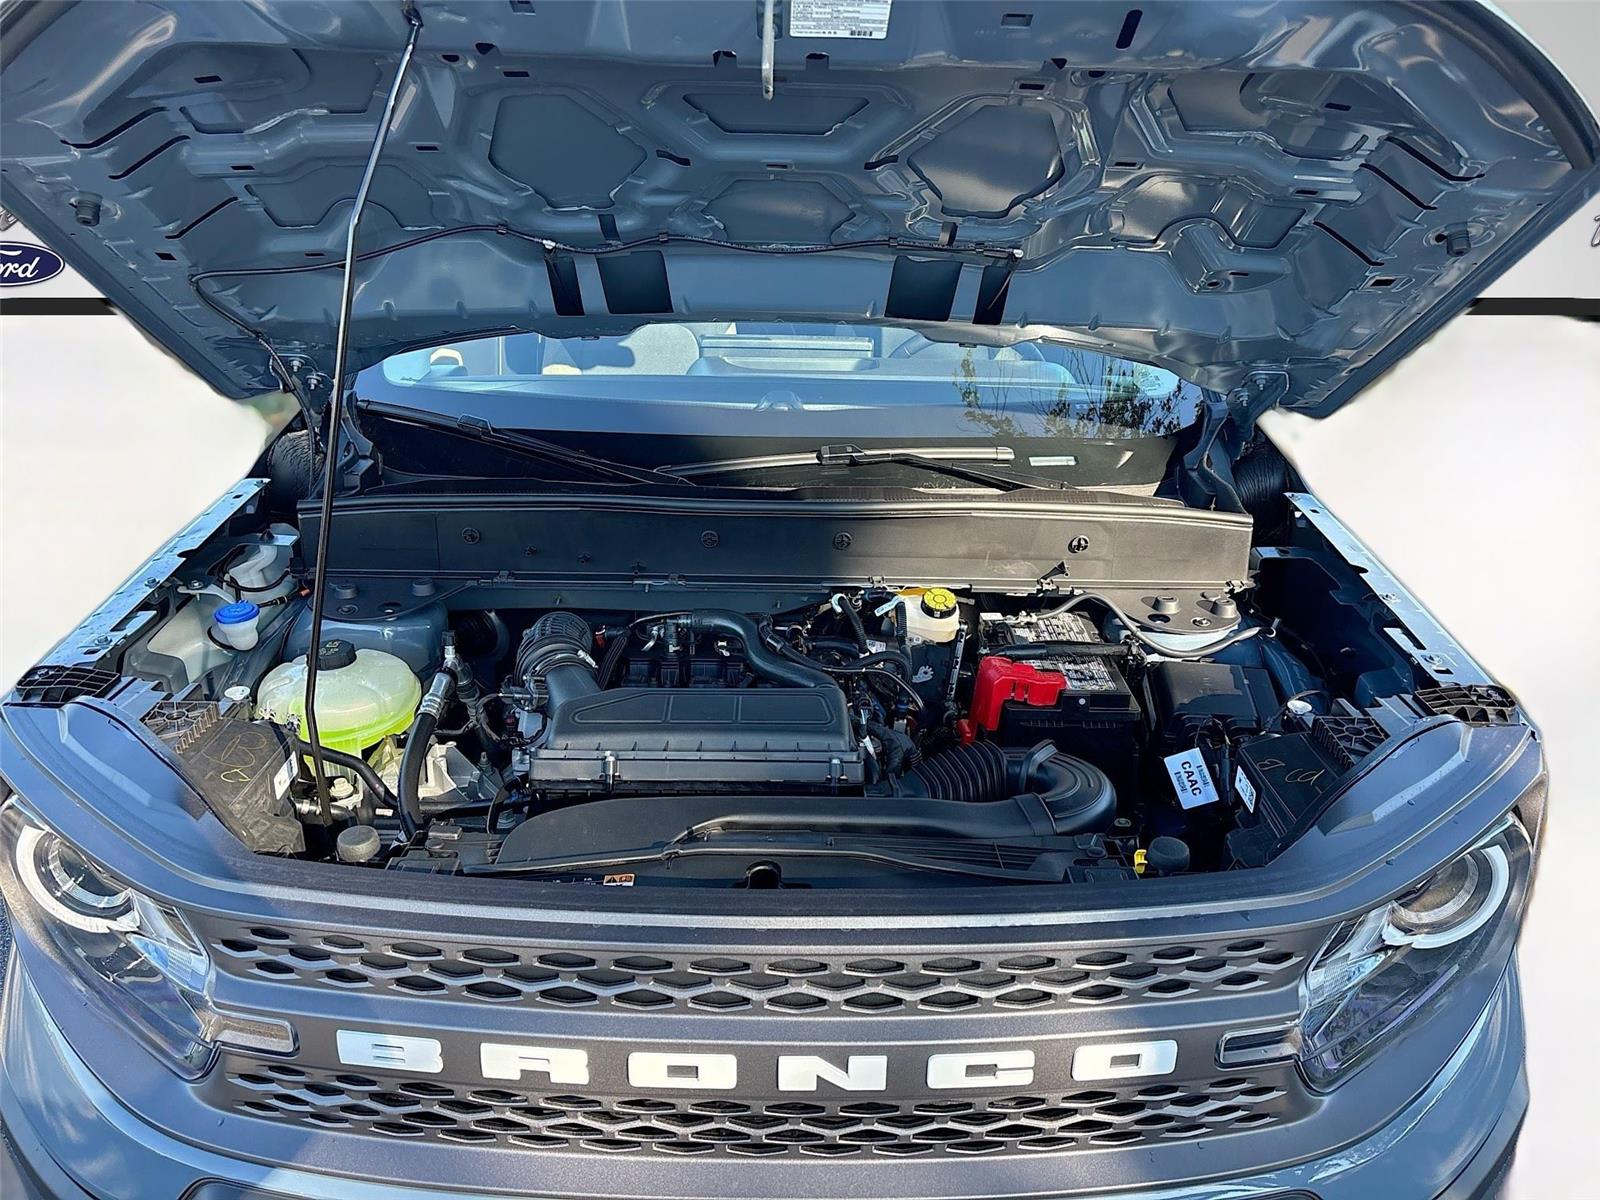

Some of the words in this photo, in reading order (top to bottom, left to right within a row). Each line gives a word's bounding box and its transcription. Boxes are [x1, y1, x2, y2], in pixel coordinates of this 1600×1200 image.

[0, 250, 41, 278] rd
[1181, 760, 1202, 797] CAAC
[336, 1029, 1178, 1092] BRONCO
